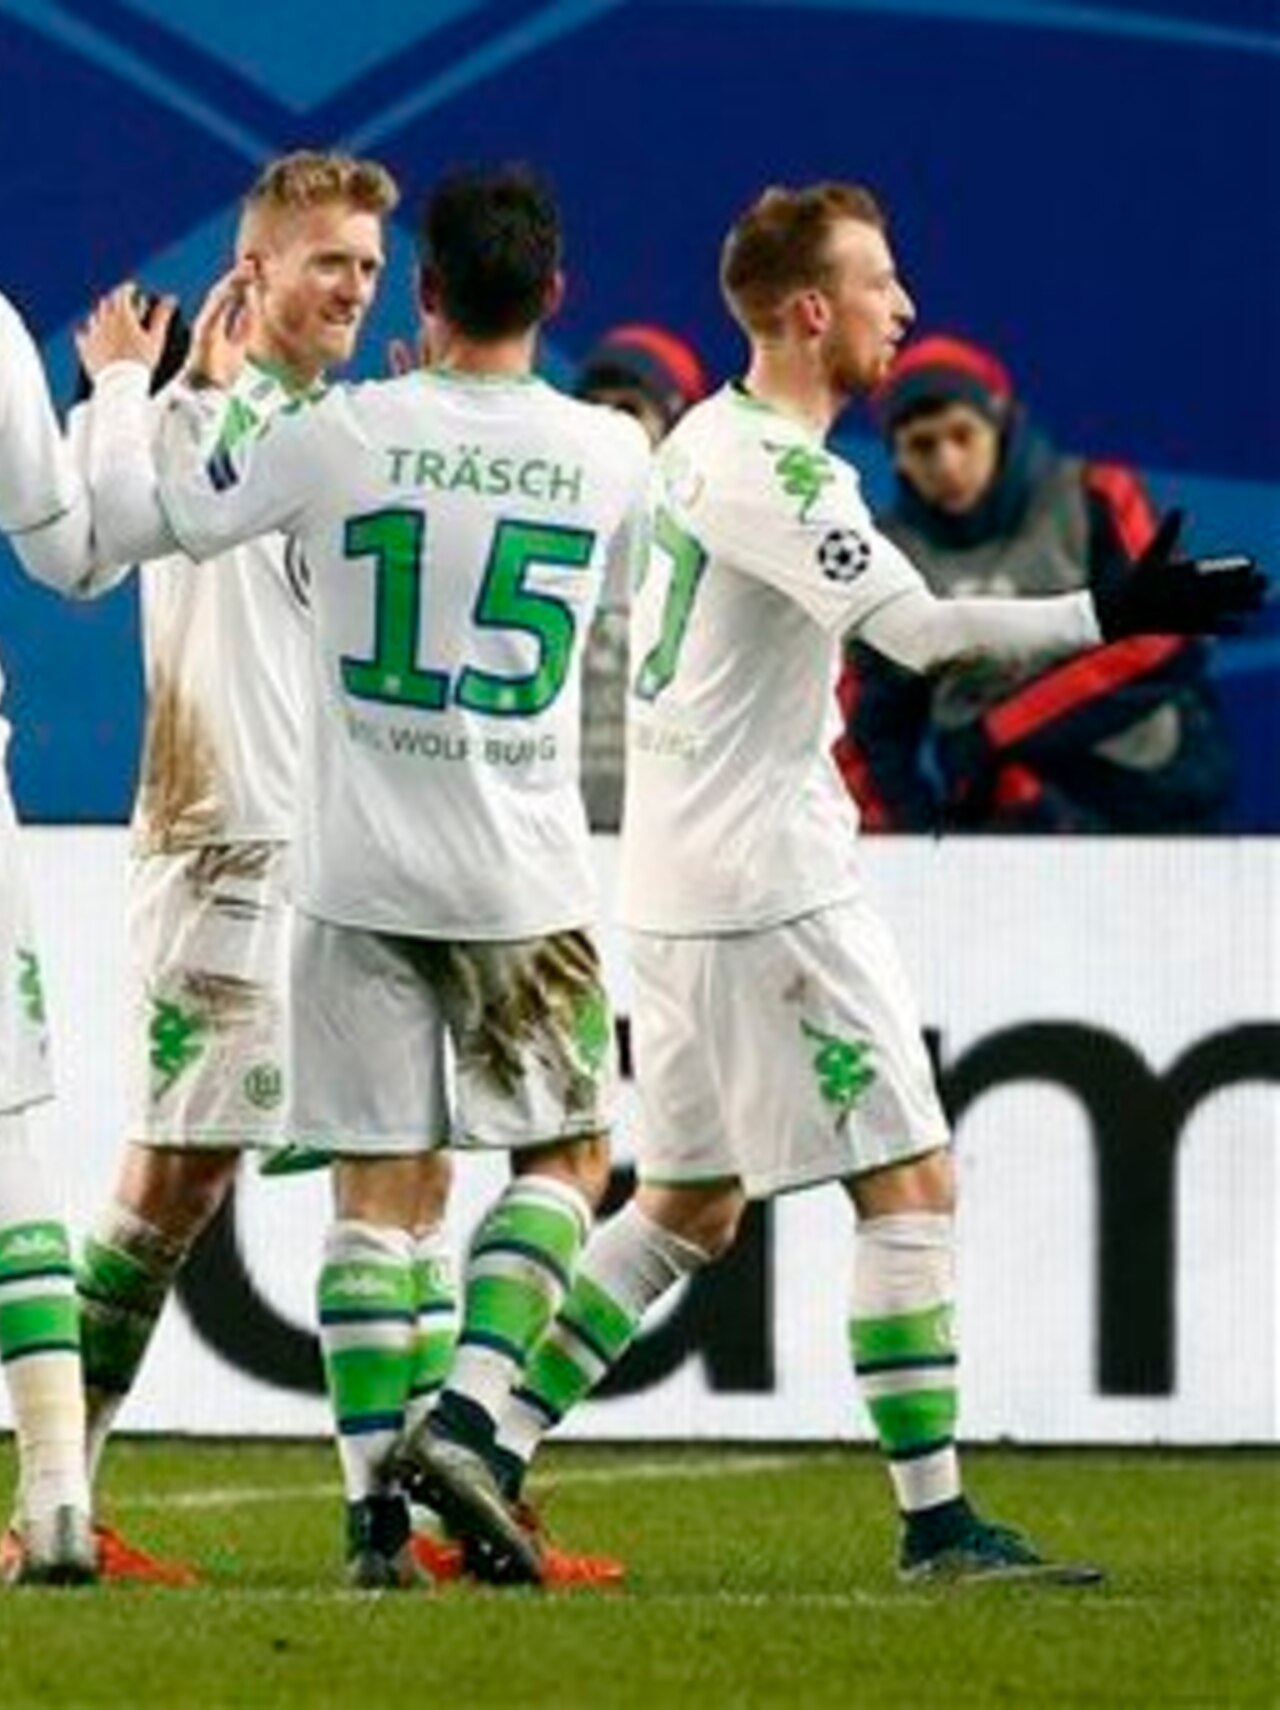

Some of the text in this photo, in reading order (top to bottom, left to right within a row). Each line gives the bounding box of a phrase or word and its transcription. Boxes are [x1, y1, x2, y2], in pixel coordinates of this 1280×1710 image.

[385, 443, 584, 502] TRÄSCH
[339, 507, 596, 717] 15
[388, 724, 558, 766] WOLFBURG
